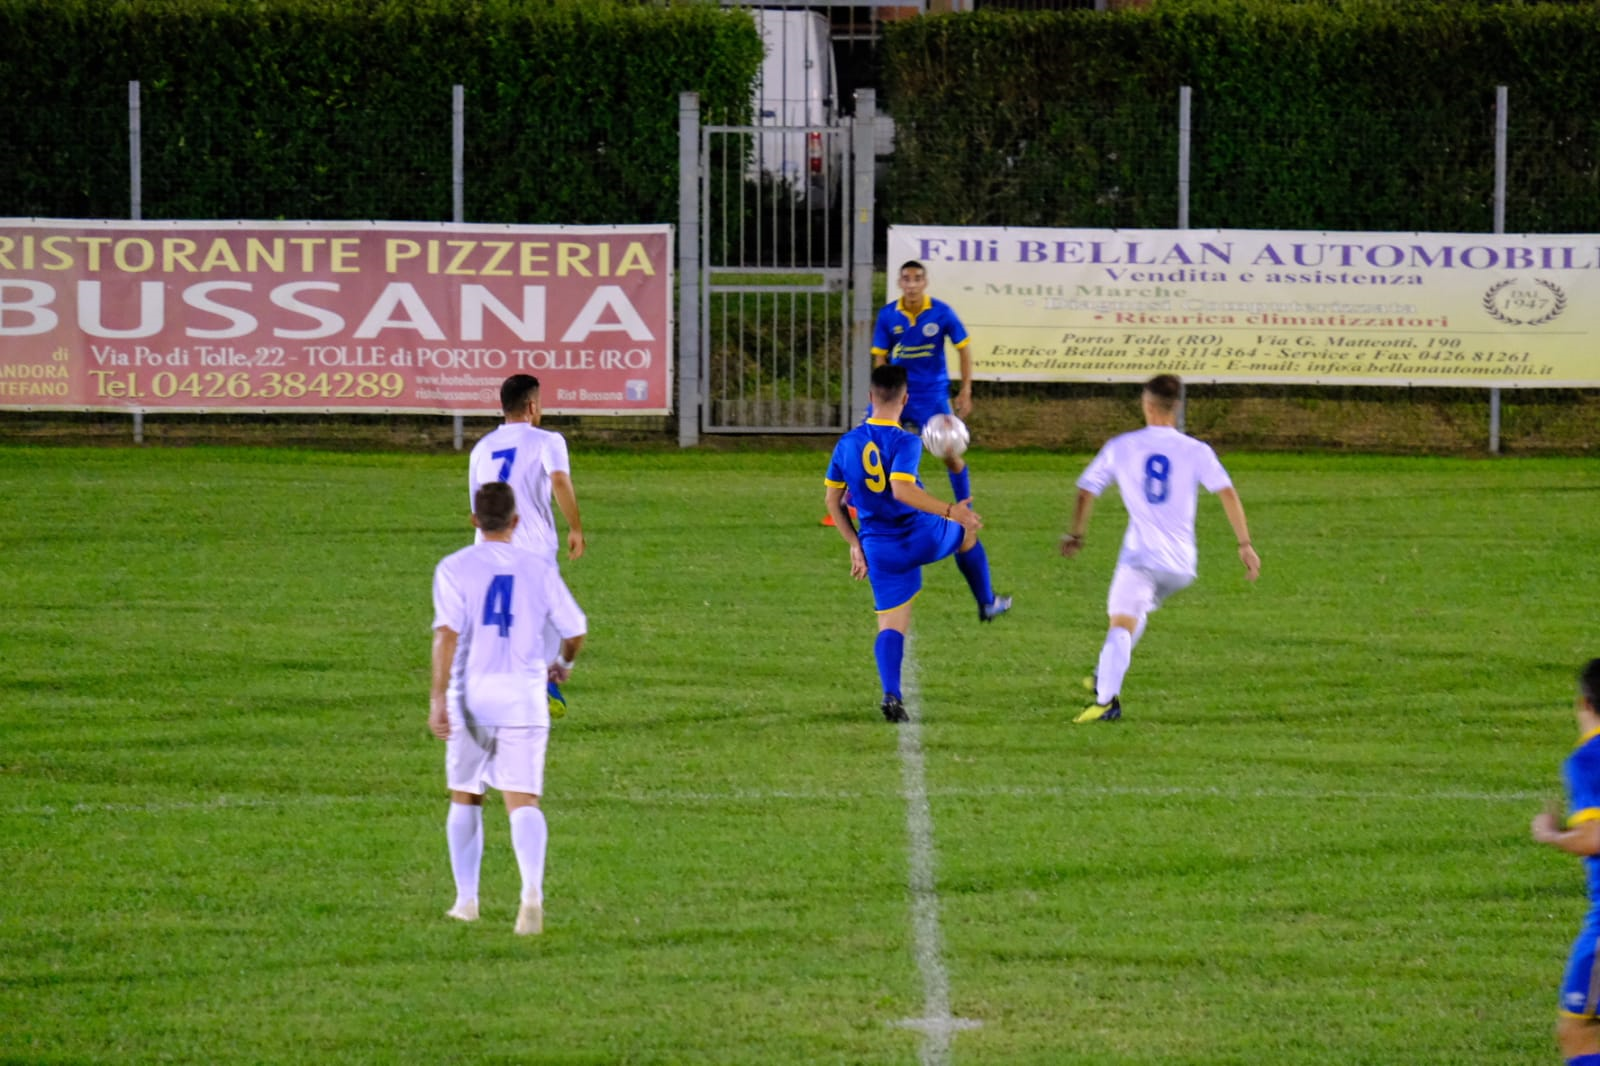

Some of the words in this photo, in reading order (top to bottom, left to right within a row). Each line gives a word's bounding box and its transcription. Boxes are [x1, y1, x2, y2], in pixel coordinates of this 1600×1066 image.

[0, 235, 360, 273] RISTORANTE
[385, 238, 656, 277] PIZZERIA
[916, 238, 1000, 262] F.lli
[1016, 239, 1234, 266] BELLAN
[1105, 267, 1227, 284] Vendita
[1239, 273, 1254, 283] e
[1266, 270, 1424, 285] assistenza
[985, 283, 1064, 297] Multi
[1074, 284, 1188, 299] Marche
[0, 278, 656, 344] BUSSANA
[1504, 299, 1550, 310] 1947
[1115, 311, 1235, 326] Ricarica
[1246, 312, 1450, 329] climatizzatori
[52, 346, 69, 361] di
[991, 344, 1058, 357] Enrico
[1064, 346, 1127, 358] Bellan
[1133, 346, 1170, 358] 340
[1277, 349, 1350, 360] Service
[1355, 352, 1366, 360] e
[1373, 350, 1411, 361] Fax
[1418, 351, 1465, 362] 0426
[1471, 351, 1531, 363] 81261
[1061, 333, 1115, 345] Porto
[1123, 334, 1171, 346] Tolle
[1176, 335, 1223, 347] (RO)
[1256, 336, 1288, 346] Via
[1427, 338, 1462, 349] 190
[91, 345, 129, 366] Via
[134, 346, 162, 367] Po
[166, 348, 189, 367] di
[302, 346, 386, 367] TOLLE
[390, 348, 412, 367] di
[418, 348, 507, 369] PORTO
[511, 349, 596, 369] TOLLE
[598, 348, 652, 369] (RO)
[88, 370, 146, 398] Tel.
[151, 371, 404, 399] 0426.384289
[491, 447, 517, 483] 7
[861, 441, 886, 493] 9
[1144, 454, 1171, 503] 8
[482, 574, 515, 637] 4
